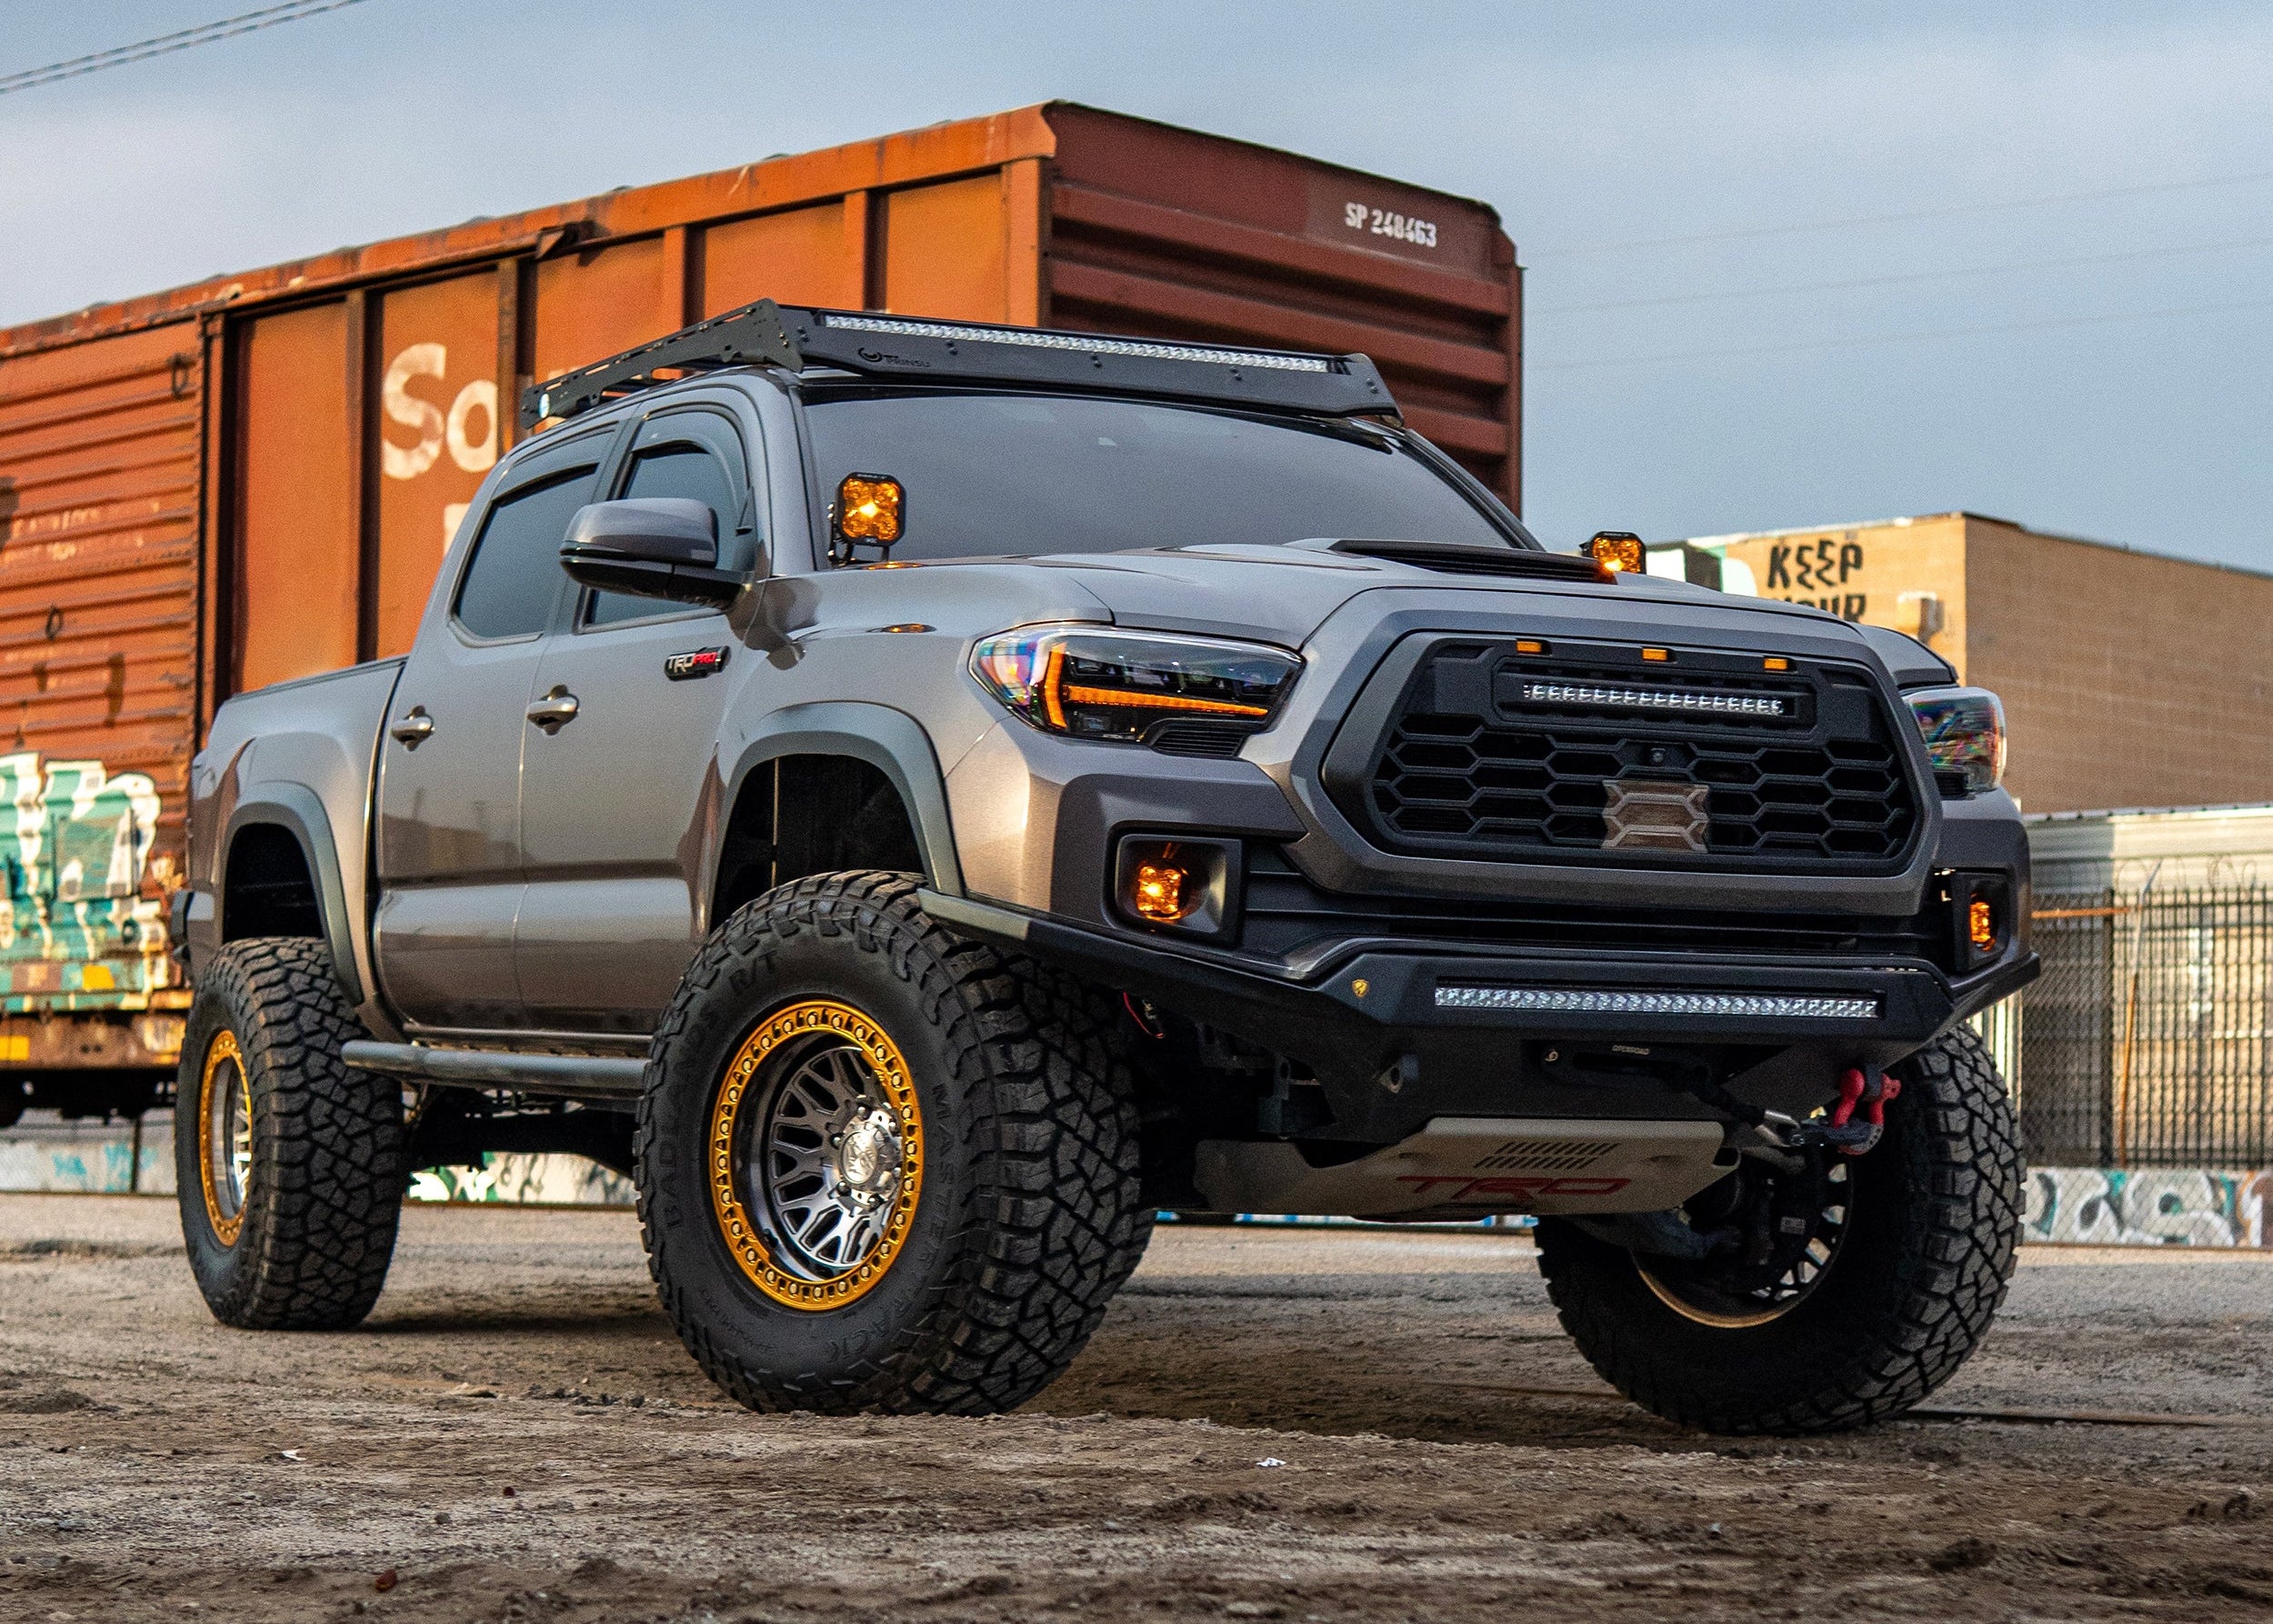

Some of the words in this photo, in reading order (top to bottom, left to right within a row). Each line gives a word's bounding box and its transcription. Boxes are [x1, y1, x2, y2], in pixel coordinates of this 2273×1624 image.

[1345, 202, 1367, 229] SP
[1371, 209, 1437, 247] 248463
[1767, 538, 1864, 591] KEEP
[694, 652, 716, 664] PRO
[729, 950, 778, 997] R/T
[1397, 1175, 1631, 1201] TRD
